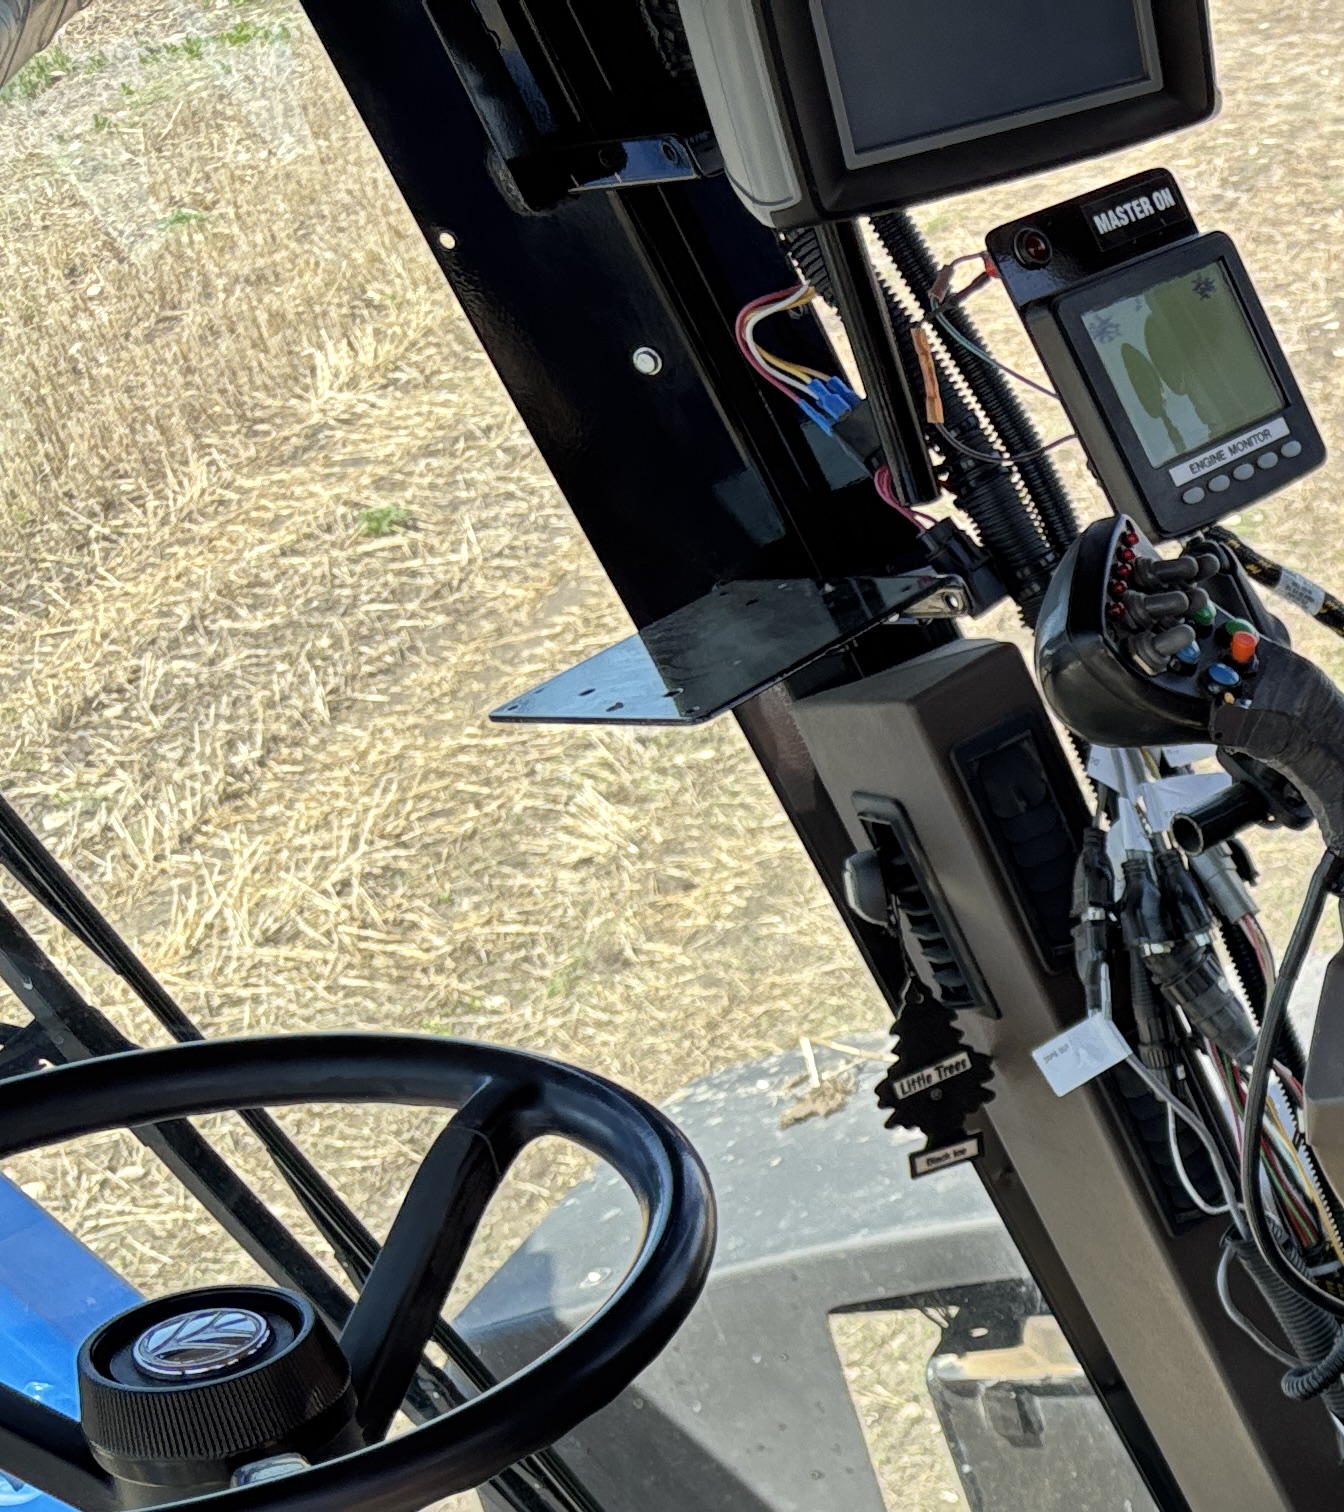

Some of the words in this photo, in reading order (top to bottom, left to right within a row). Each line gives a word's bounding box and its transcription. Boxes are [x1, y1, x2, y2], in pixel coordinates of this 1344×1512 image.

[1093, 198, 1154, 235] MASTER
[1151, 187, 1177, 213] ON
[1188, 450, 1228, 475] ENGINE
[1227, 428, 1273, 457] MONITOR
[899, 1072, 933, 1096] Little
[934, 1059, 967, 1080] Trees
